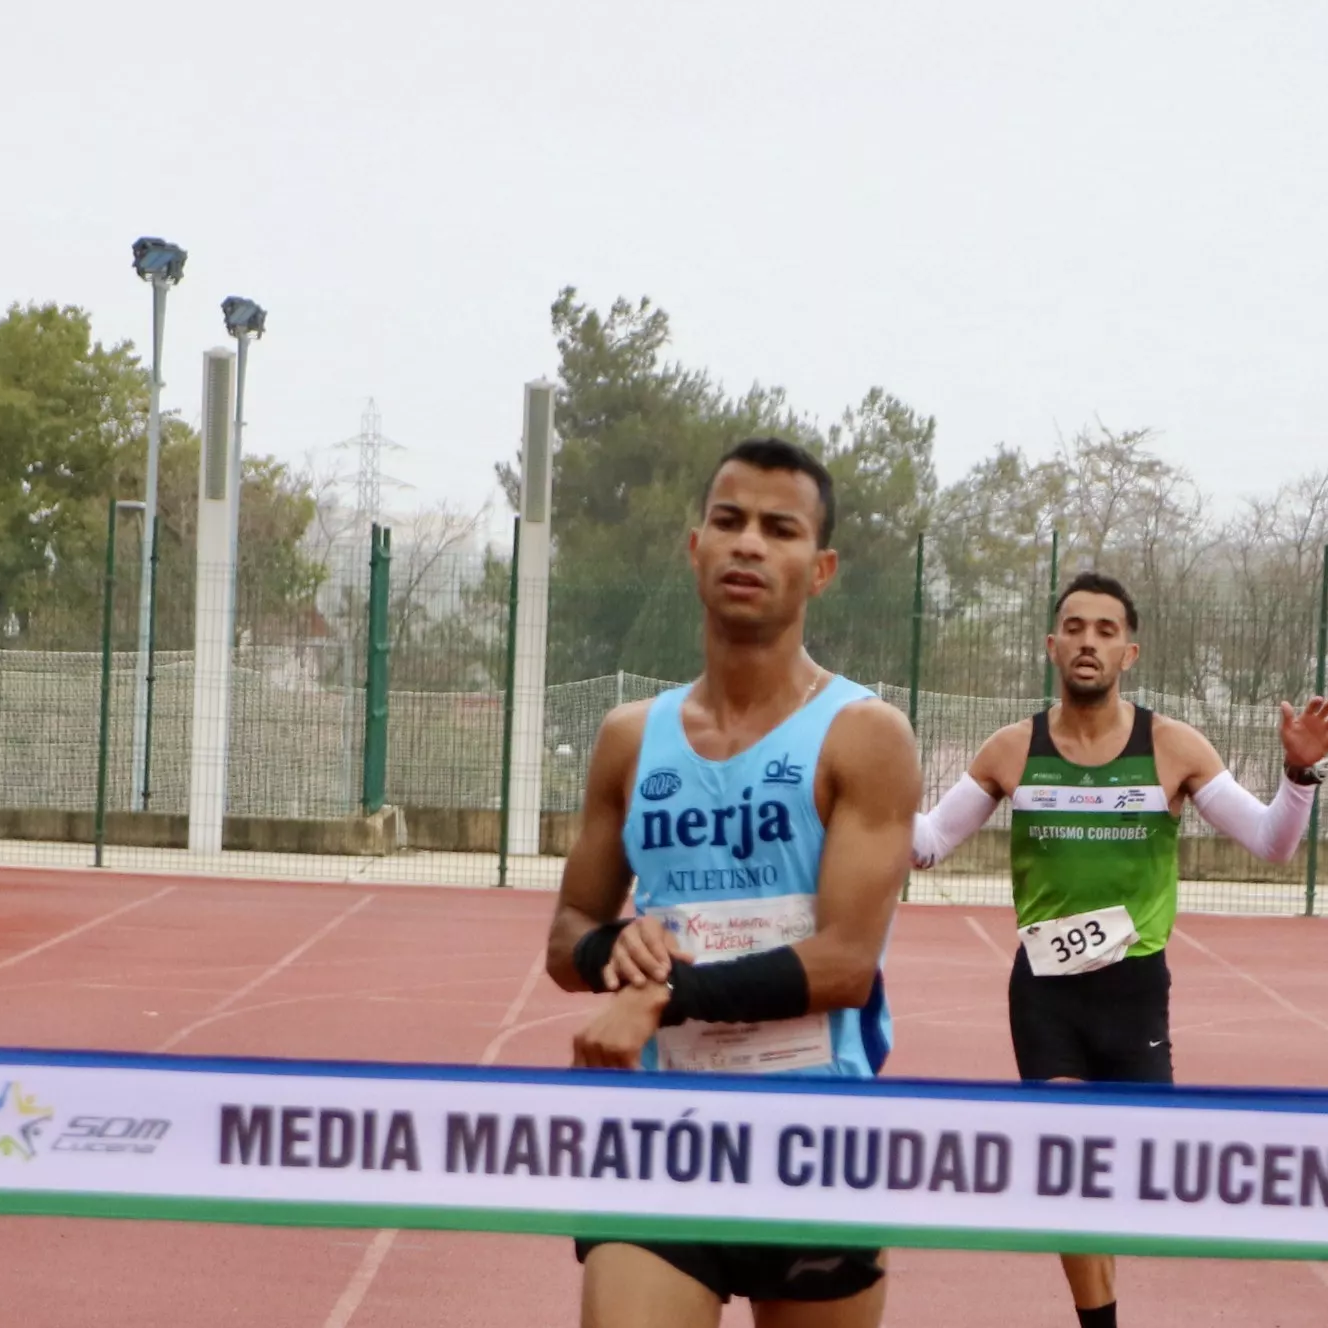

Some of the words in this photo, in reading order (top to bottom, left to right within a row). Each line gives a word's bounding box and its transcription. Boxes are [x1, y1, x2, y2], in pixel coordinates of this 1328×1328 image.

[642, 786, 794, 860] nerja
[1088, 824, 1148, 840] CORDOBÉS
[666, 865, 778, 892] ATLETISMO
[1051, 920, 1106, 963] 393
[218, 1104, 422, 1172] MEDIA
[444, 1108, 751, 1184] MARATÓN
[777, 1124, 1011, 1196] CIUDAD
[1036, 1135, 1116, 1199] DE
